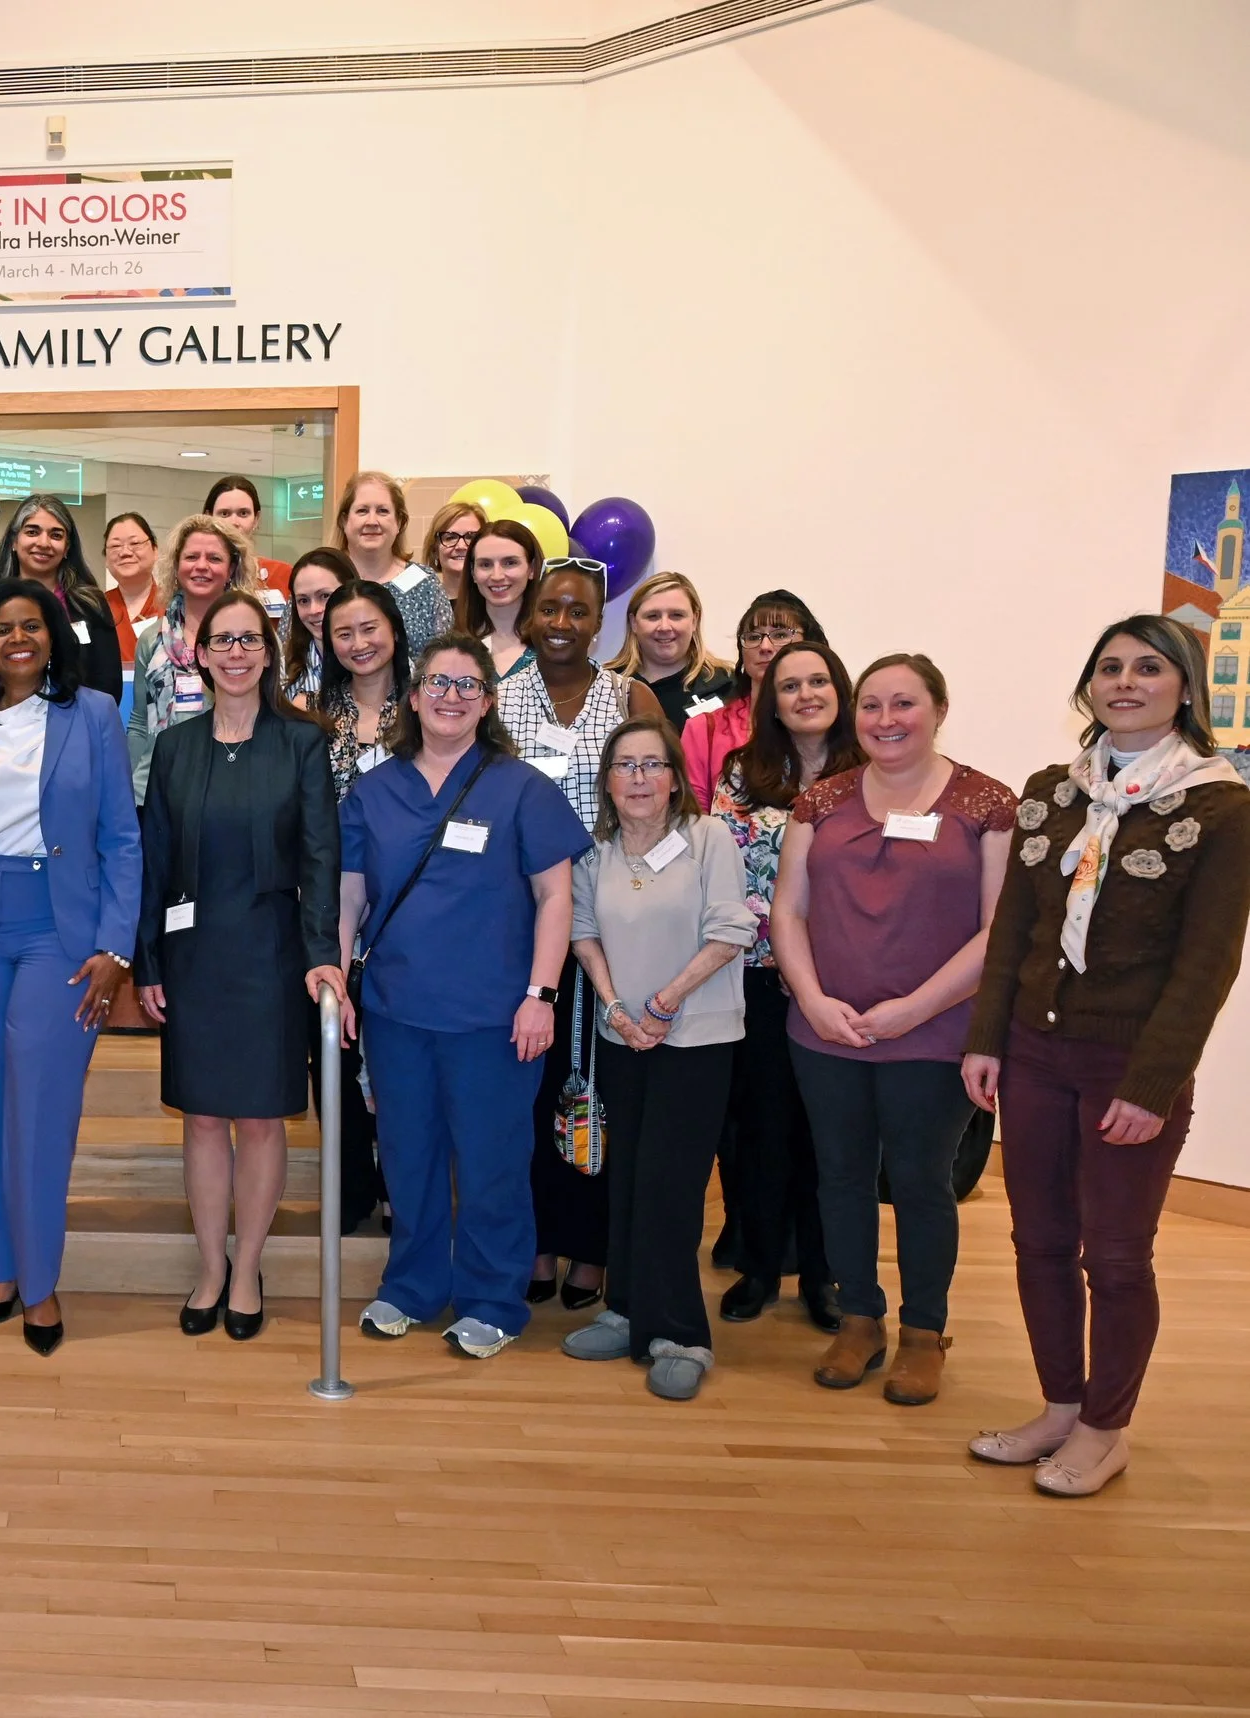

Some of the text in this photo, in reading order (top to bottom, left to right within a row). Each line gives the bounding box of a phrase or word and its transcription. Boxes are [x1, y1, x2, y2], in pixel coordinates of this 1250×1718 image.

[14, 197, 46, 225] IN
[59, 193, 187, 224] COLORS
[28, 228, 180, 249] Hershson-Weiner
[45, 264, 55, 277] 4
[70, 261, 118, 277] March
[124, 261, 143, 275] 26
[139, 323, 342, 364] GALLERY
